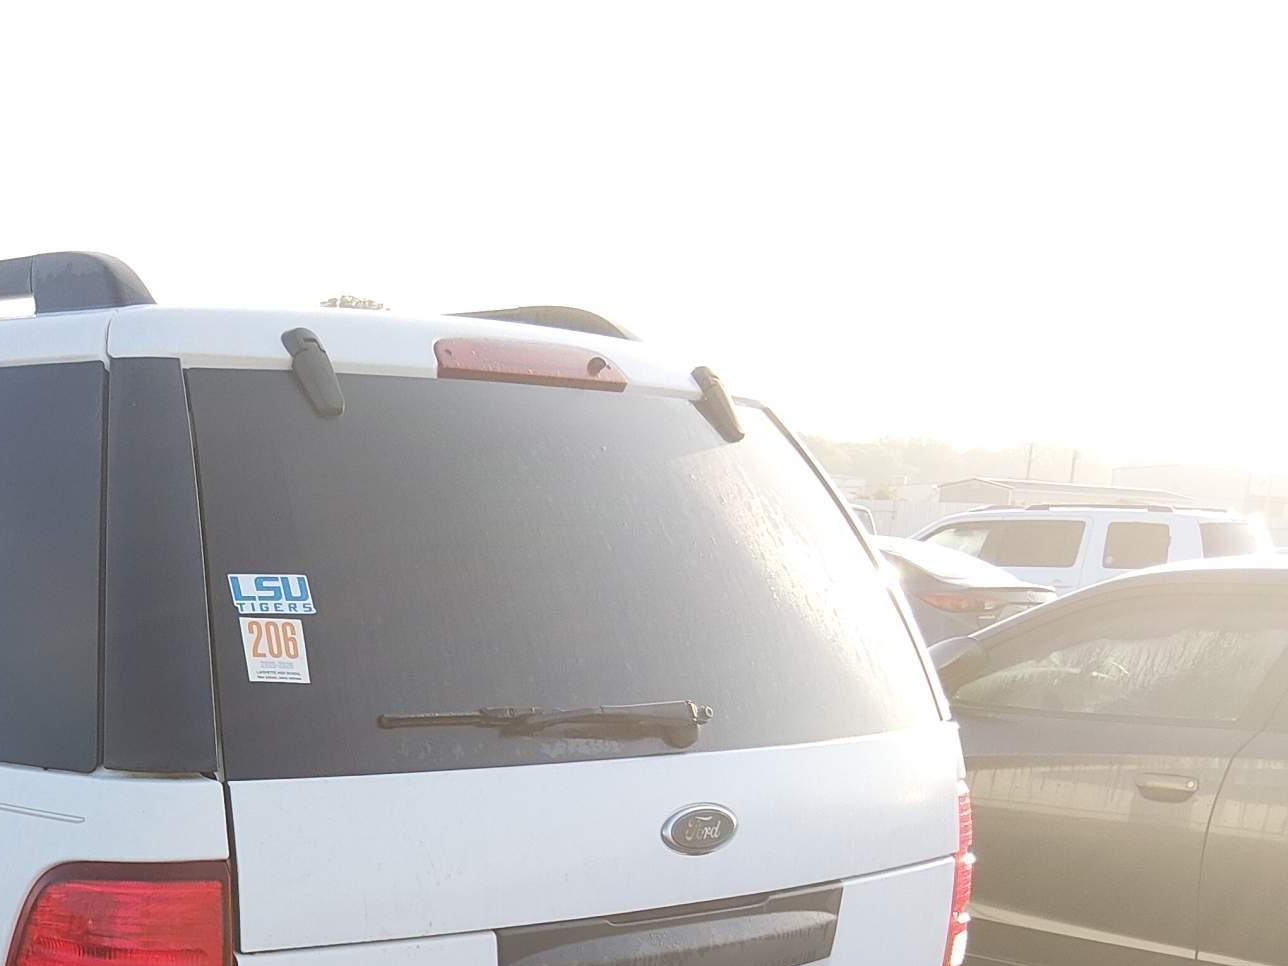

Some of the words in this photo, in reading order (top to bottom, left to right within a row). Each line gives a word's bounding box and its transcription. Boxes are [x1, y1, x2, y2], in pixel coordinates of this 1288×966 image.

[229, 576, 310, 602] LSU
[236, 602, 315, 613] TIGERS
[247, 620, 300, 659] 206
[684, 815, 722, 841] Ford
